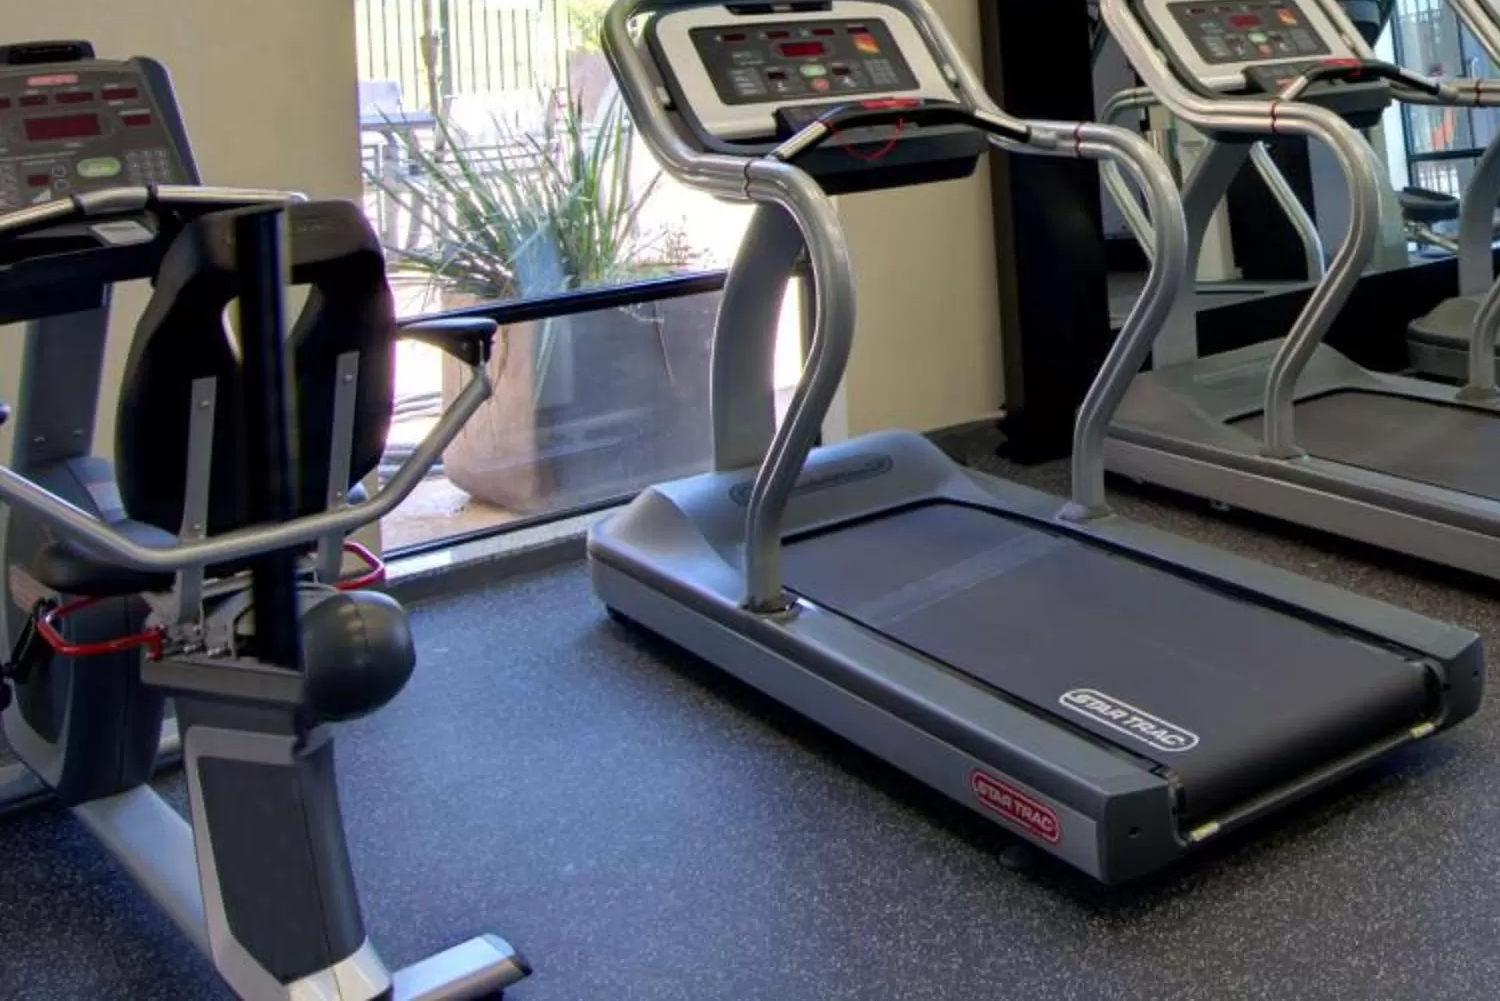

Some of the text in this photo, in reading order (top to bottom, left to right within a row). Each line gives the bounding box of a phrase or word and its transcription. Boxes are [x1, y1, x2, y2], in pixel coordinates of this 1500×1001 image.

[1070, 693, 1185, 746] STAR TRAC
[976, 780, 1054, 833] STAR TRAC
